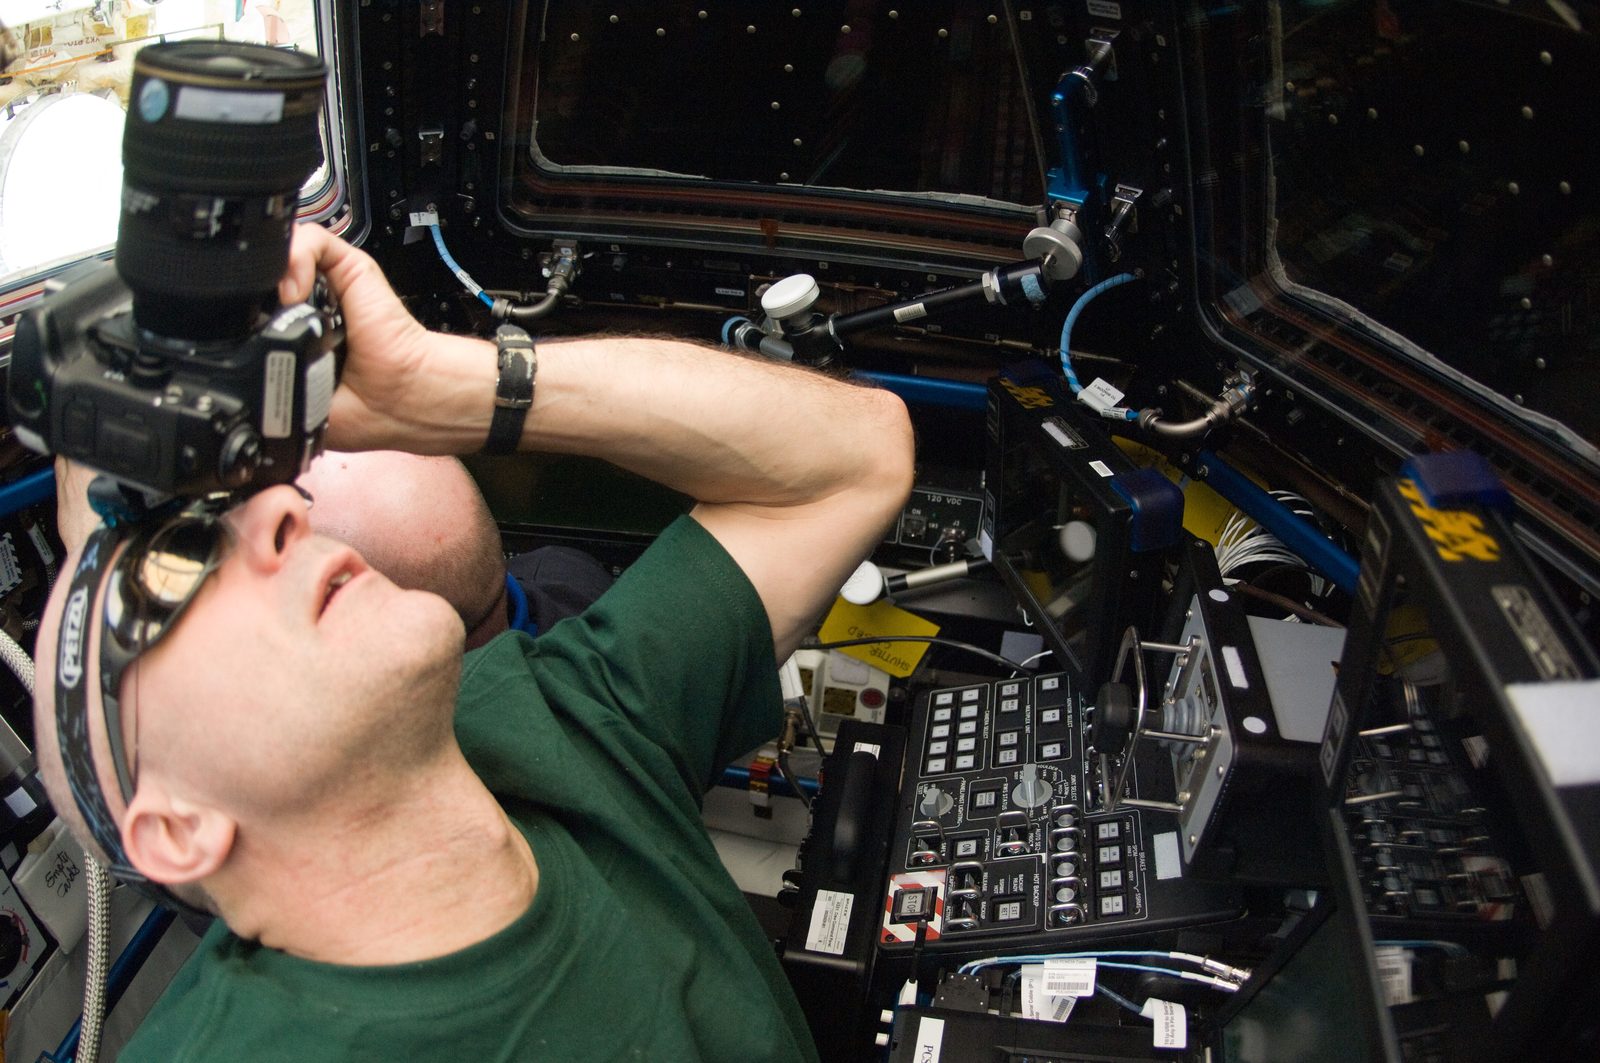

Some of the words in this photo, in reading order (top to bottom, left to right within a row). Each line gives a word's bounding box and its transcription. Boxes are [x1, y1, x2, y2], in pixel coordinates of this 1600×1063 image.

[927, 494, 942, 502] 120
[946, 497, 962, 505] VDC
[870, 645, 910, 671] SHUTTER
[962, 843, 972, 853] ON
[45, 851, 74, 888] Empty
[906, 895, 918, 913] STOP
[920, 1044, 934, 1063] PCS
